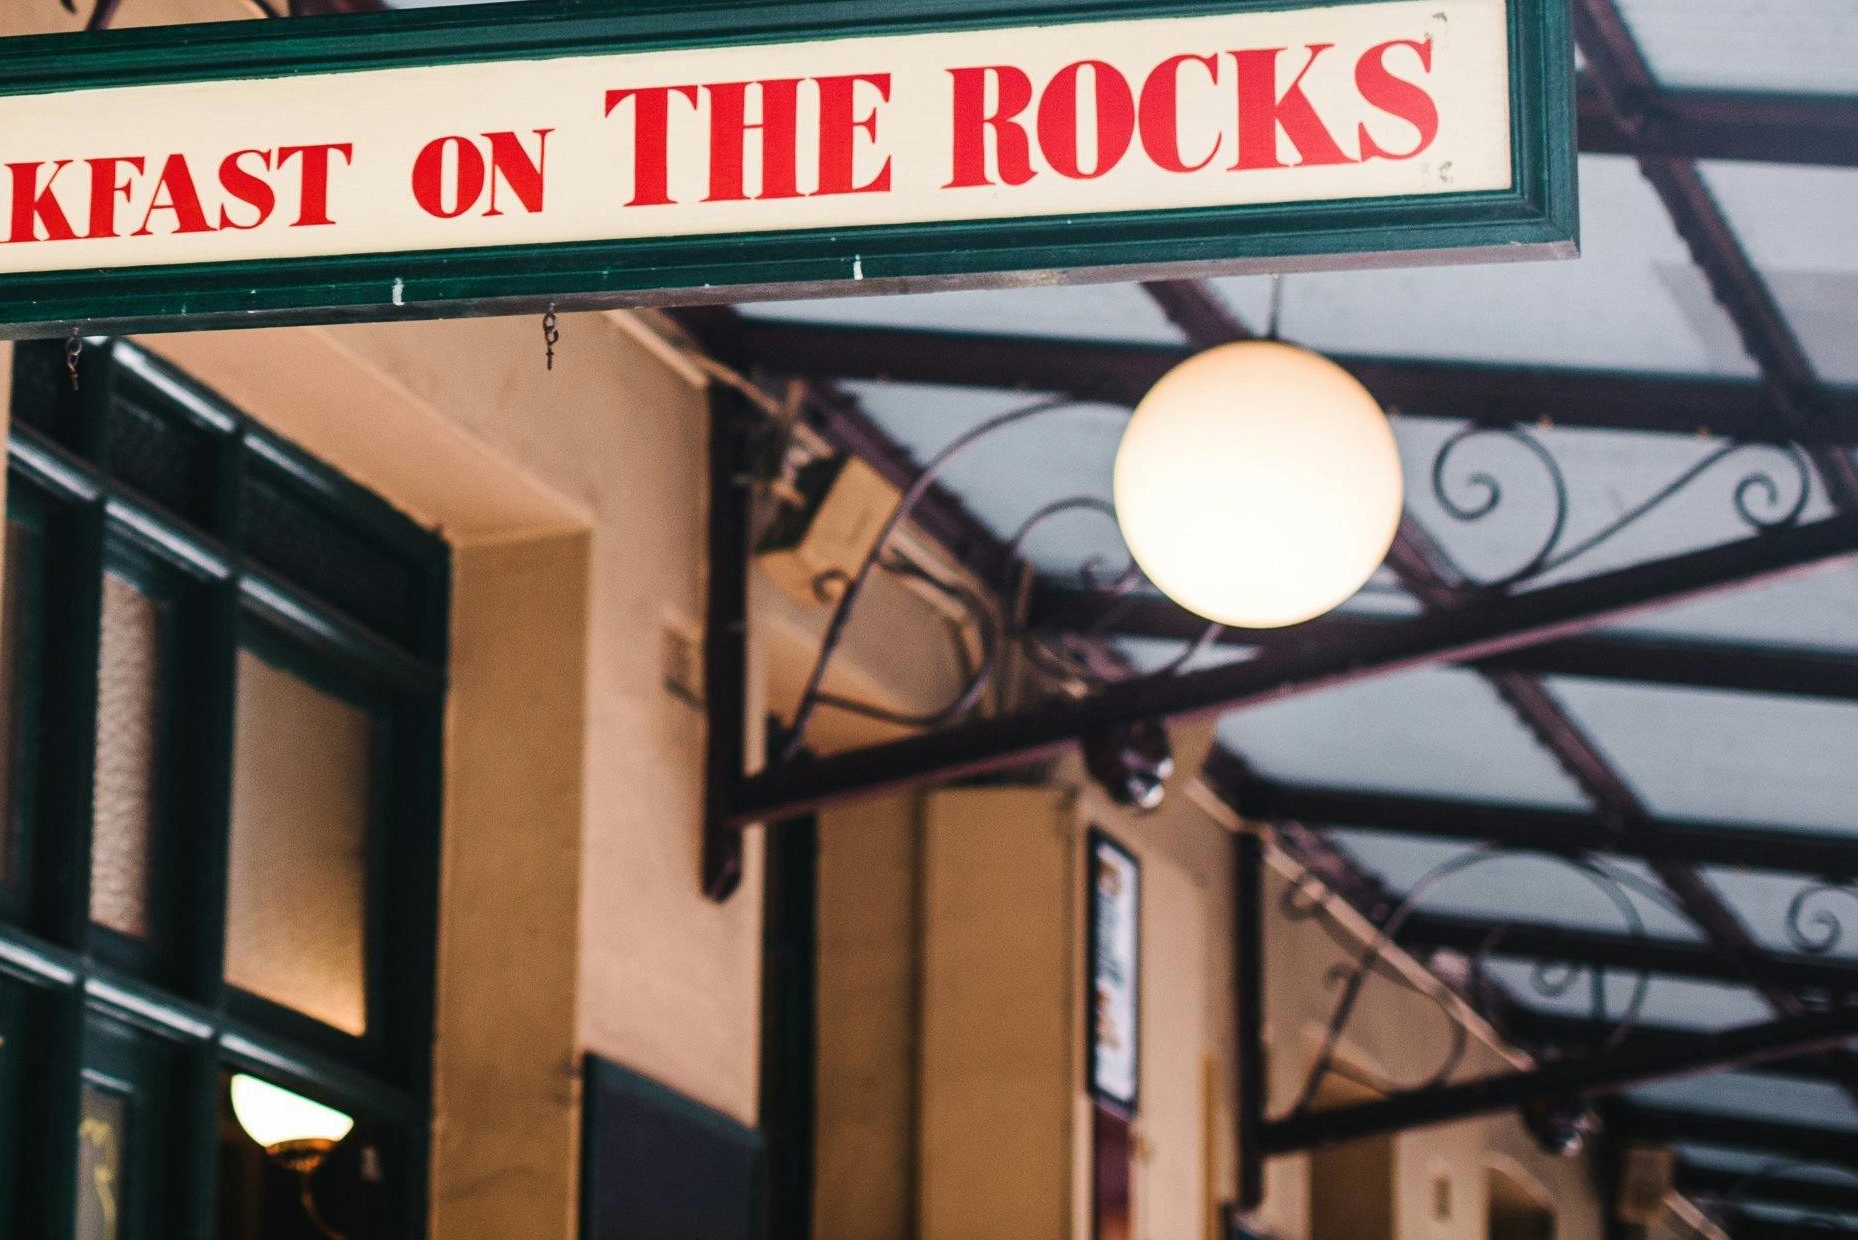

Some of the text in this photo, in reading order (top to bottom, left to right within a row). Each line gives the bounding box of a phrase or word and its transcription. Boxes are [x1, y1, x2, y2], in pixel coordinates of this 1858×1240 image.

[410, 127, 555, 219] ON
[603, 71, 893, 207] THE
[941, 37, 1441, 189] ROCKS
